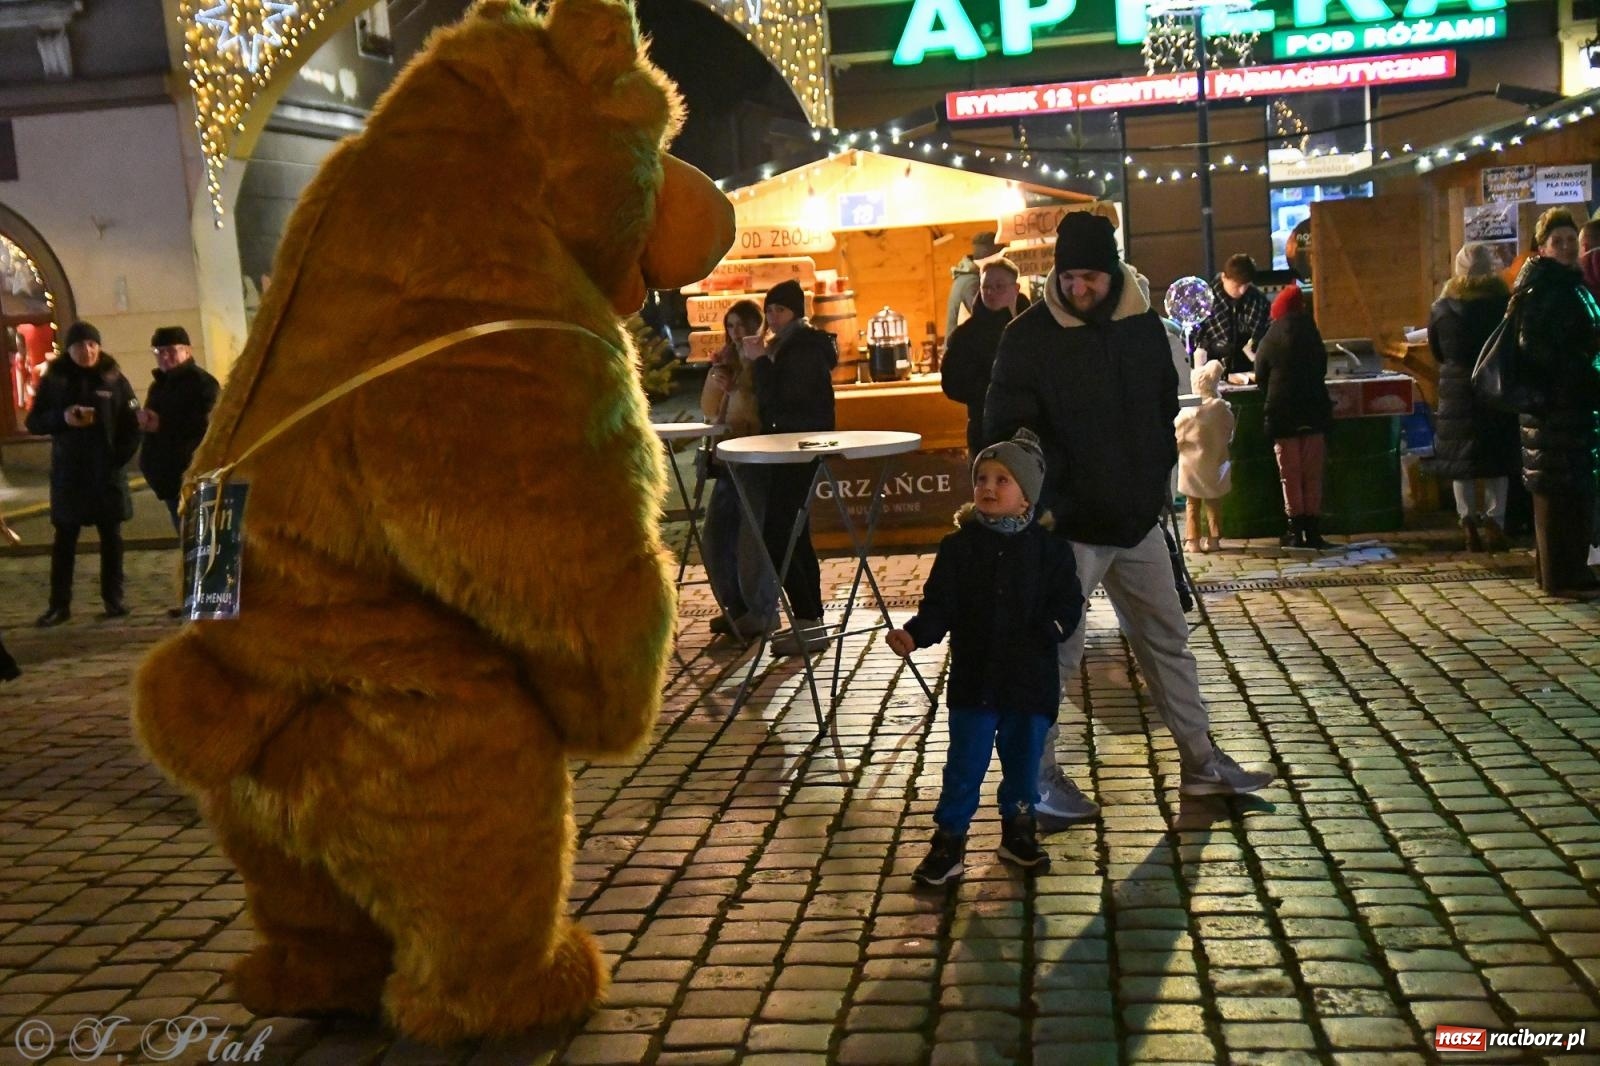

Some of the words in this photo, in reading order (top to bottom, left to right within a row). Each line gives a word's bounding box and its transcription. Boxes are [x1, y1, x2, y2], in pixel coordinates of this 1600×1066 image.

[1286, 30, 1355, 57] POD
[1364, 16, 1496, 49] RÓŻAMI
[955, 90, 1039, 116] RYNEK
[1043, 87, 1073, 109] 12
[1090, 76, 1208, 106] CENTRUM
[741, 231, 763, 249] OD
